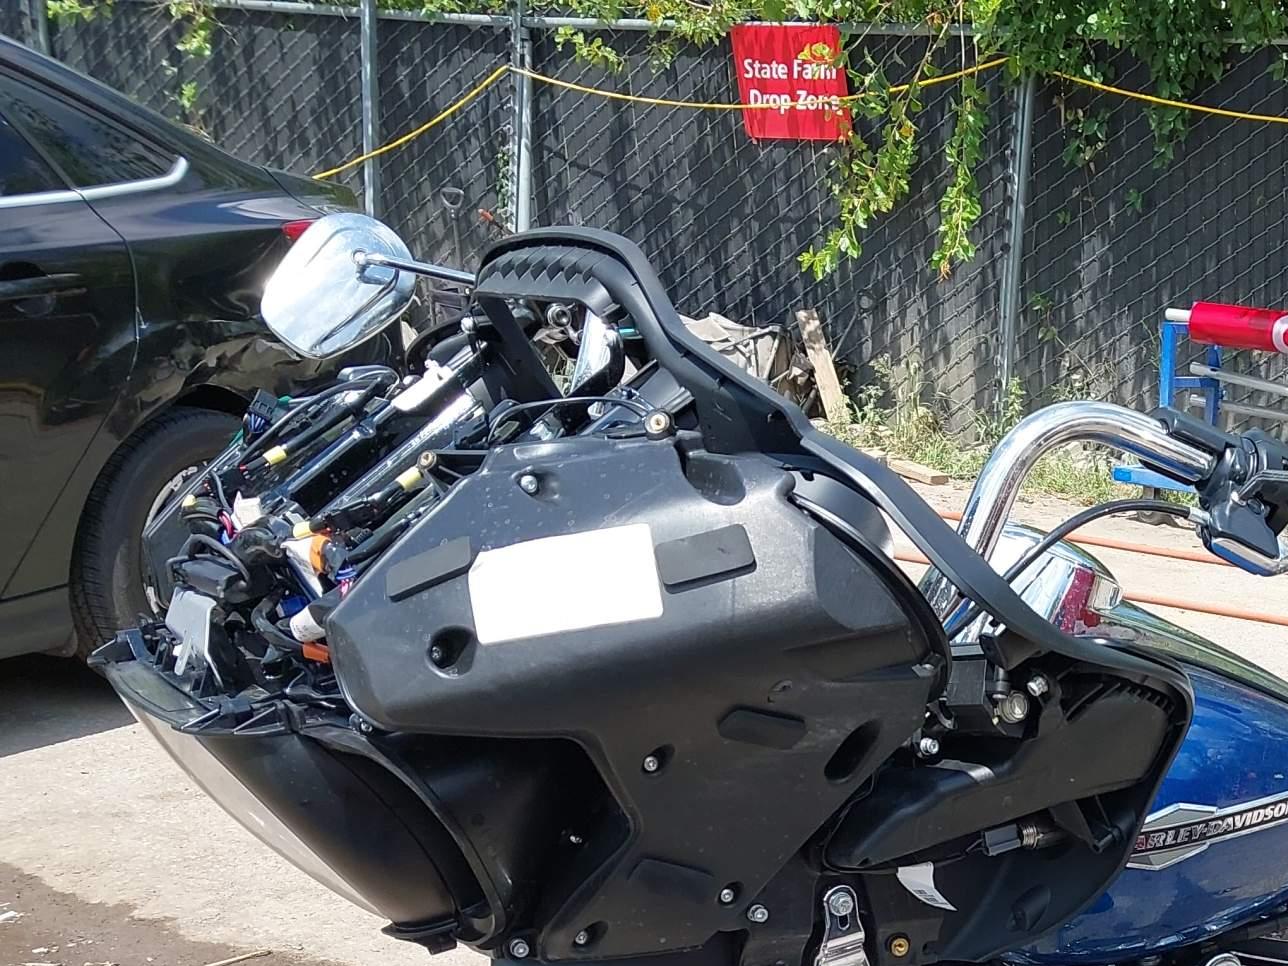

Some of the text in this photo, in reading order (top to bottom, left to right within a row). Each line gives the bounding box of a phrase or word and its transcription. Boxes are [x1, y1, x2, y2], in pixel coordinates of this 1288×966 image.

[743, 58, 837, 80] State Fam
[748, 88, 840, 115] Drop Zone
